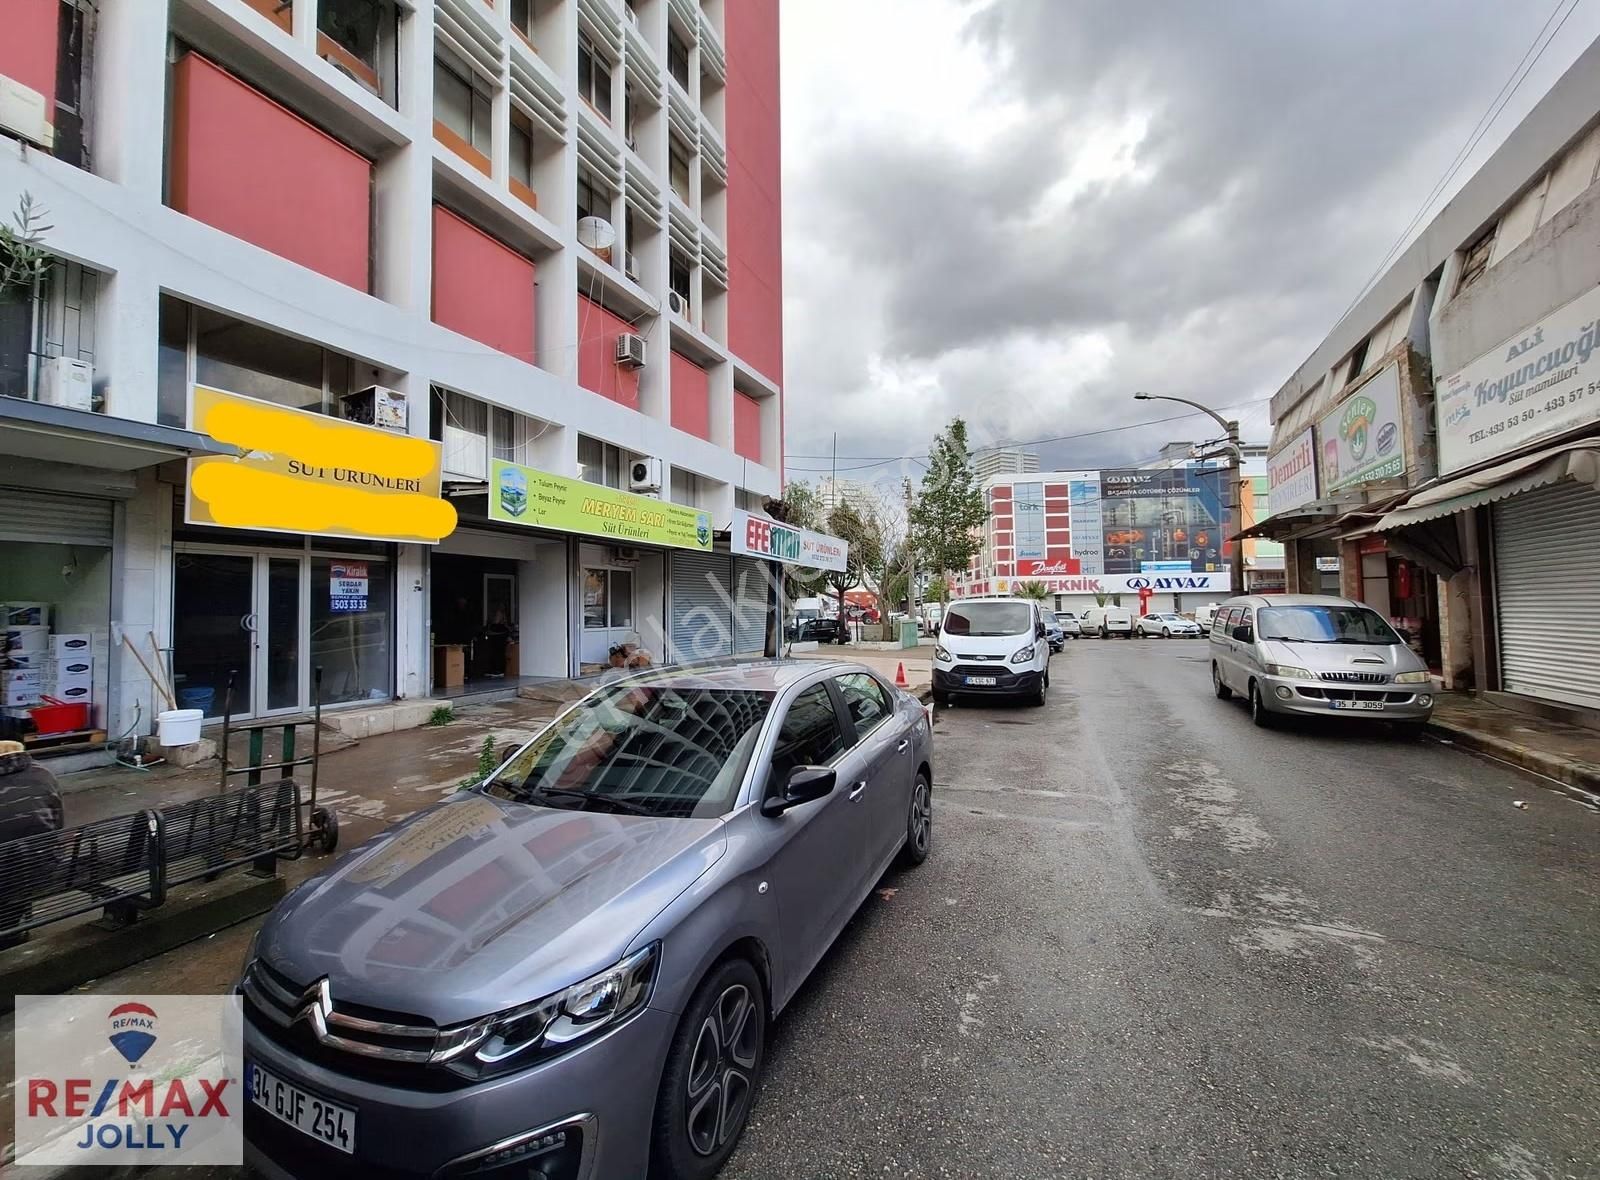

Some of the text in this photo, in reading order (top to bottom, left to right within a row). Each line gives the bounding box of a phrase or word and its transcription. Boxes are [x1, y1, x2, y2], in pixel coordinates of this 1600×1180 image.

[1505, 326, 1545, 363] ALİ
[1508, 362, 1579, 406] Süt mamülleri
[1507, 415, 1519, 429] 53
[1521, 408, 1535, 422] 50
[1569, 388, 1583, 403] 57
[1121, 475, 1152, 483] AYVAZ
[1269, 439, 1312, 490] Demirli
[581, 497, 637, 523] MERYEM
[602, 521, 649, 538] Süt Ürünleri
[746, 519, 769, 553] EFE
[1153, 577, 1210, 589] AYVAZ
[335, 599, 349, 609] 503
[349, 599, 358, 609] 33
[358, 599, 367, 609] 33
[1336, 700, 1347, 708] 35
[1363, 701, 1383, 709] 3059
[252, 1065, 349, 1148] 34 GJF 254
